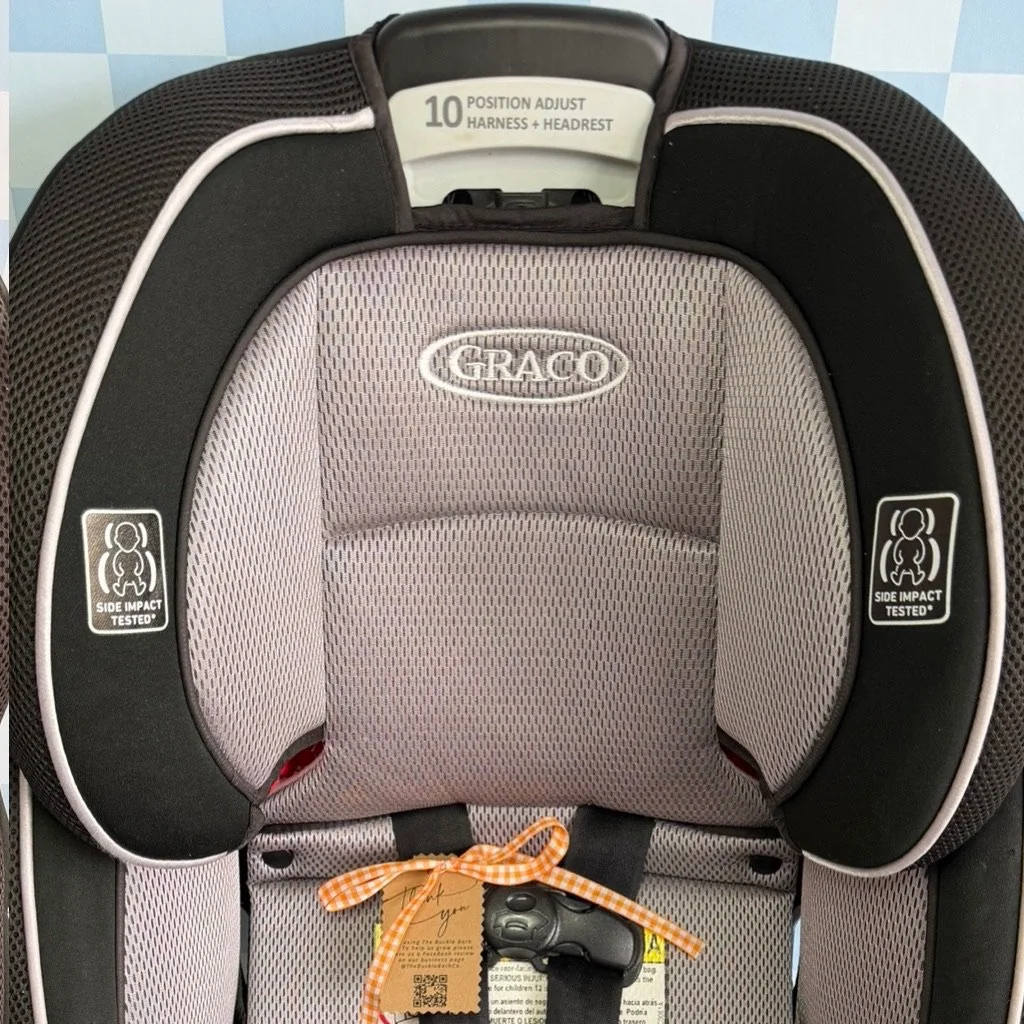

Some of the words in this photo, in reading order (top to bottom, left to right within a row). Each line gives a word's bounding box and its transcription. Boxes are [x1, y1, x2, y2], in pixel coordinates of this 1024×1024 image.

[467, 96, 531, 110] POSITION
[535, 98, 586, 111] ADJUST
[425, 95, 463, 128] 10
[467, 117, 528, 130] HARNESS
[543, 118, 614, 131] HEADREST
[449, 345, 610, 382] GRACO
[874, 591, 897, 602] SIDE
[899, 589, 943, 602] IMPACT
[96, 602, 122, 613] SIDE
[124, 599, 162, 612] IMPACT
